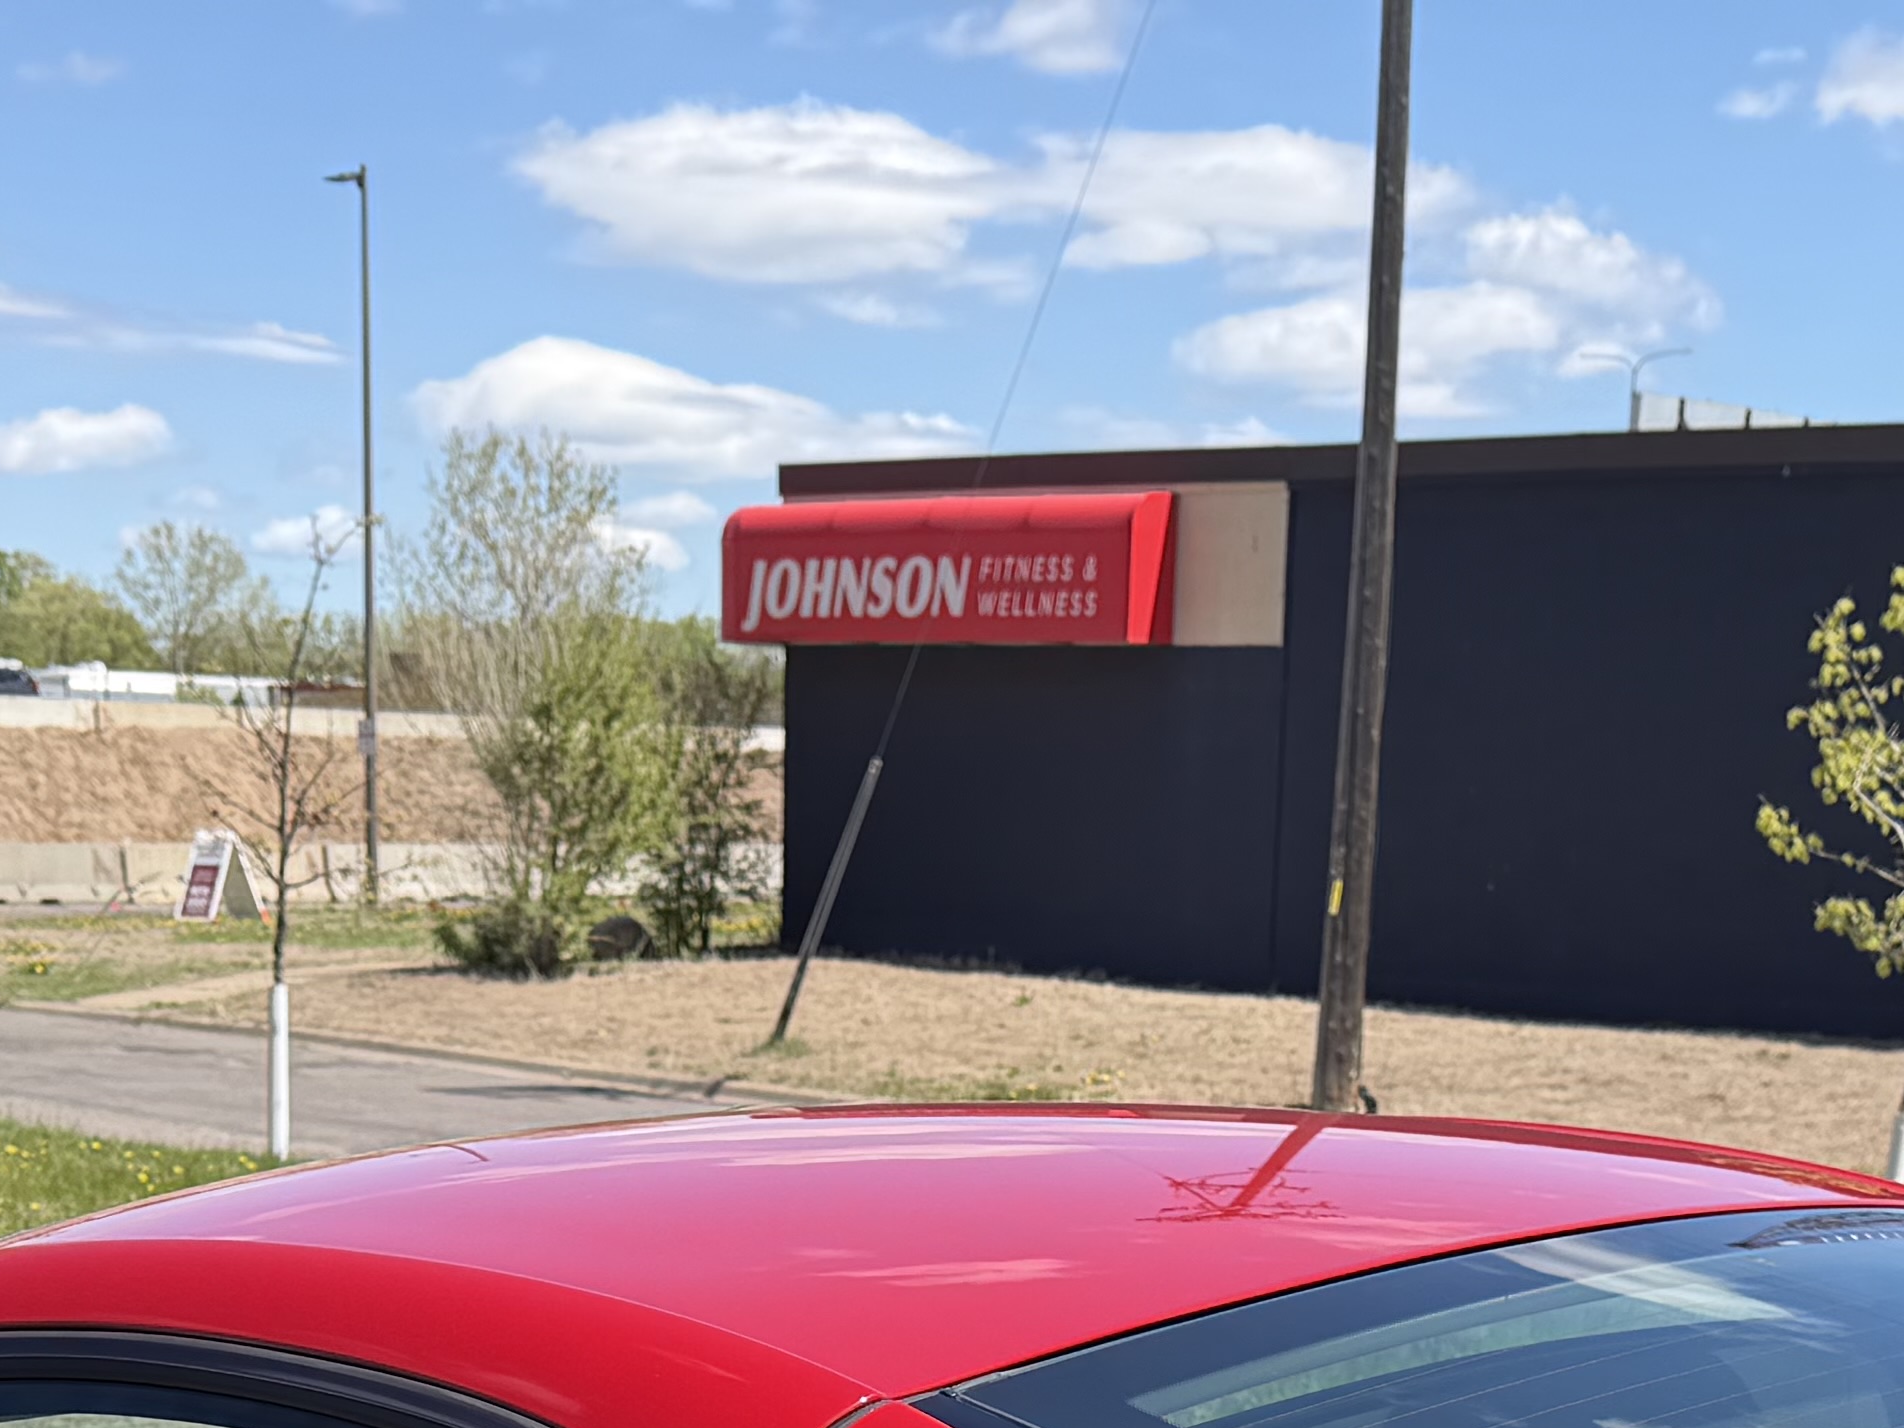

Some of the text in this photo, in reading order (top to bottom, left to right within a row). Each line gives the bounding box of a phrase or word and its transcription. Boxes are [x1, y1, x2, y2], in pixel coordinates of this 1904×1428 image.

[978, 554, 1098, 582] FITNESS &
[741, 556, 971, 632] JOHNSON
[977, 590, 1098, 617] WELLNESS
